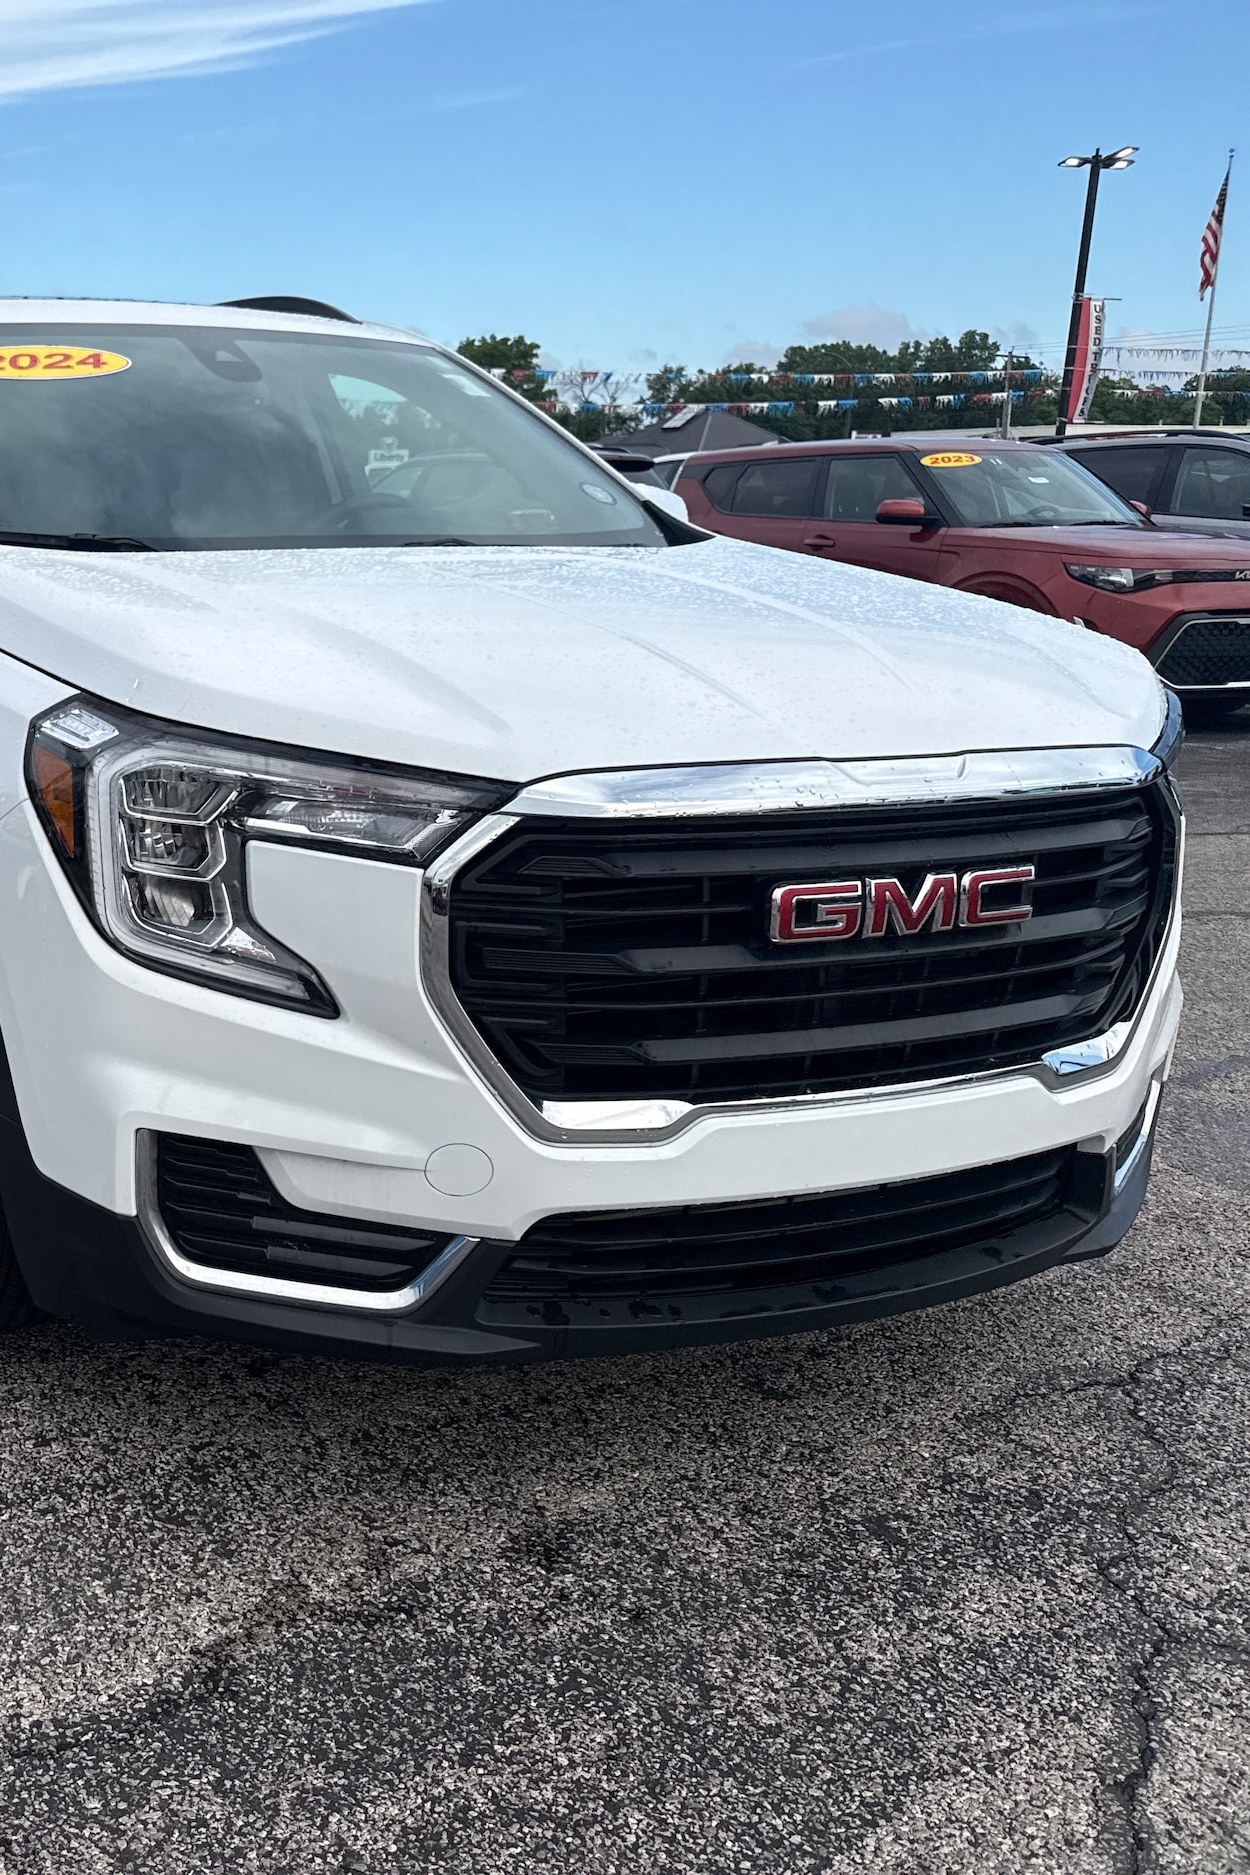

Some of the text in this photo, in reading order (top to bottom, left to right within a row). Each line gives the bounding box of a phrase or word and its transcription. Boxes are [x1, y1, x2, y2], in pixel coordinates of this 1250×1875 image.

[1092, 304, 1102, 347] USED
[929, 455, 976, 465] 2023
[769, 864, 1036, 944] GMC
